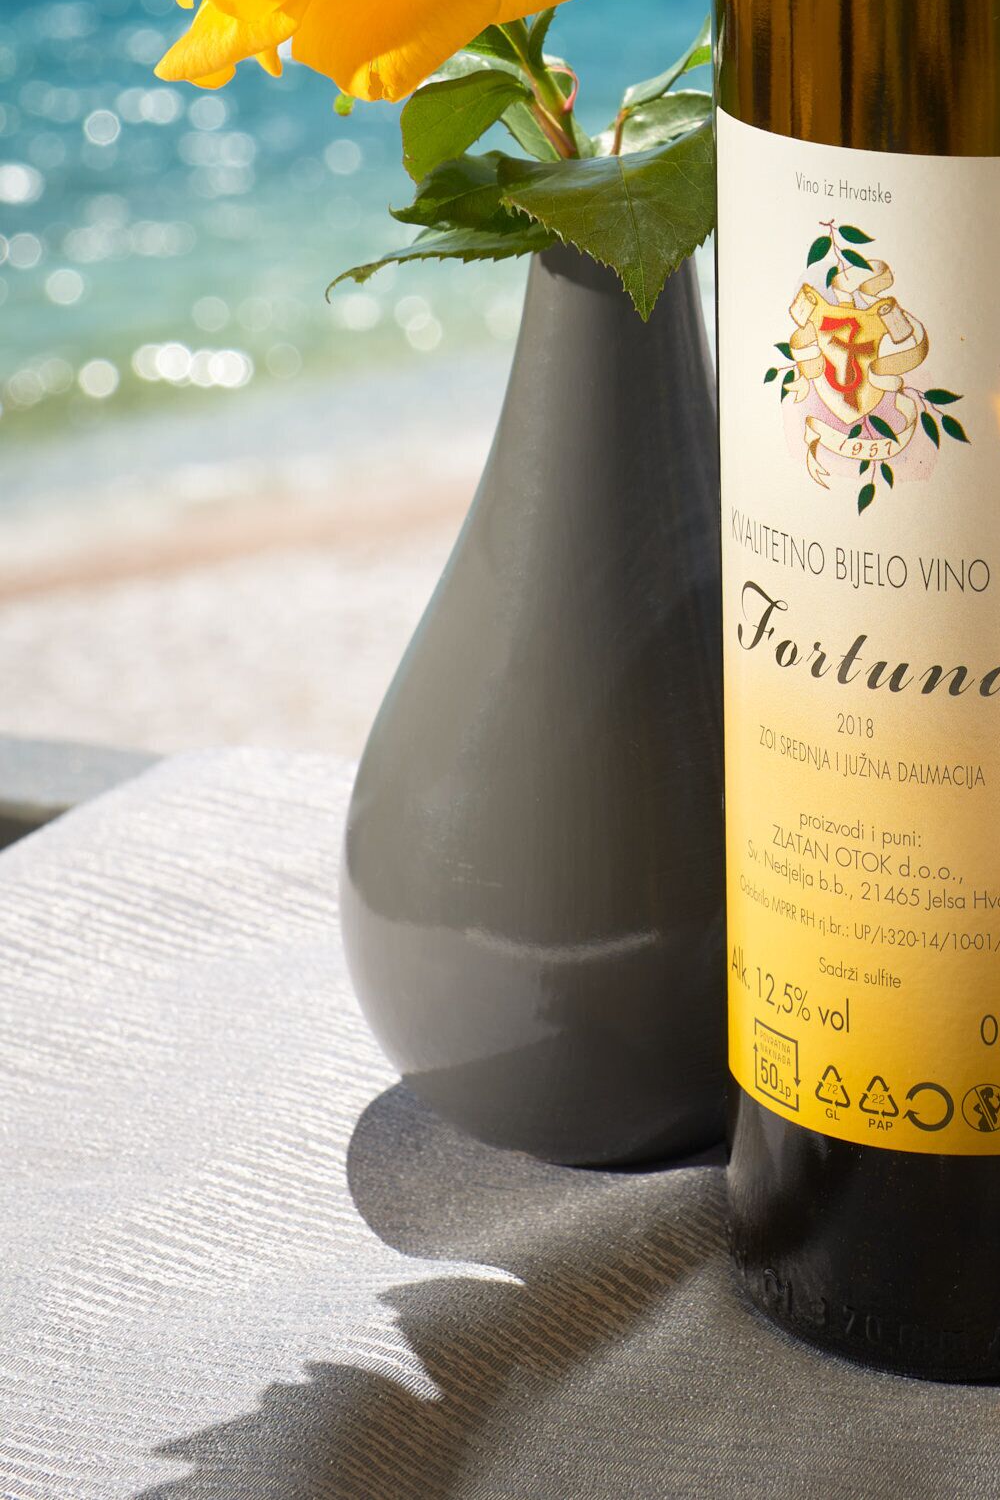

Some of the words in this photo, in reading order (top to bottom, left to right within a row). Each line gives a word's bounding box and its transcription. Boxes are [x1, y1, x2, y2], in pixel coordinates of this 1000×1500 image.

[795, 171, 819, 195] Vino
[823, 179, 834, 197] iz
[839, 180, 892, 204] Hrvatske
[731, 506, 825, 575] KVALITETNO
[835, 547, 908, 589] BIJELO
[919, 557, 990, 592] VINO
[837, 712, 874, 738] 2018
[759, 725, 776, 752] ZOI
[780, 735, 831, 771] SREDNJA
[843, 752, 891, 781] JUŽNA
[898, 762, 986, 790] DALMACIJA
[799, 811, 864, 841] proizvodi
[882, 831, 922, 848] puni:
[772, 824, 829, 864] ZLATAN
[835, 847, 892, 876] OTOK
[899, 856, 964, 884] d.o.o.,
[747, 840, 761, 864] Sv.
[764, 849, 814, 890] Nedjelja
[819, 869, 853, 900] b.b.,
[861, 882, 920, 908] 21465
[925, 889, 965, 911] Jelsa
[772, 896, 797, 921] MPRR
[800, 908, 815, 928] RH
[731, 945, 751, 991] Alk.
[757, 967, 811, 1022] 12,5%
[817, 998, 850, 1033] vol
[818, 956, 858, 983] Sadrži
[863, 968, 901, 989] sulfite
[826, 1082, 839, 1095] 72
[872, 1093, 885, 1105] 22
[825, 1108, 840, 1120] GL
[868, 1118, 893, 1131] PAP
